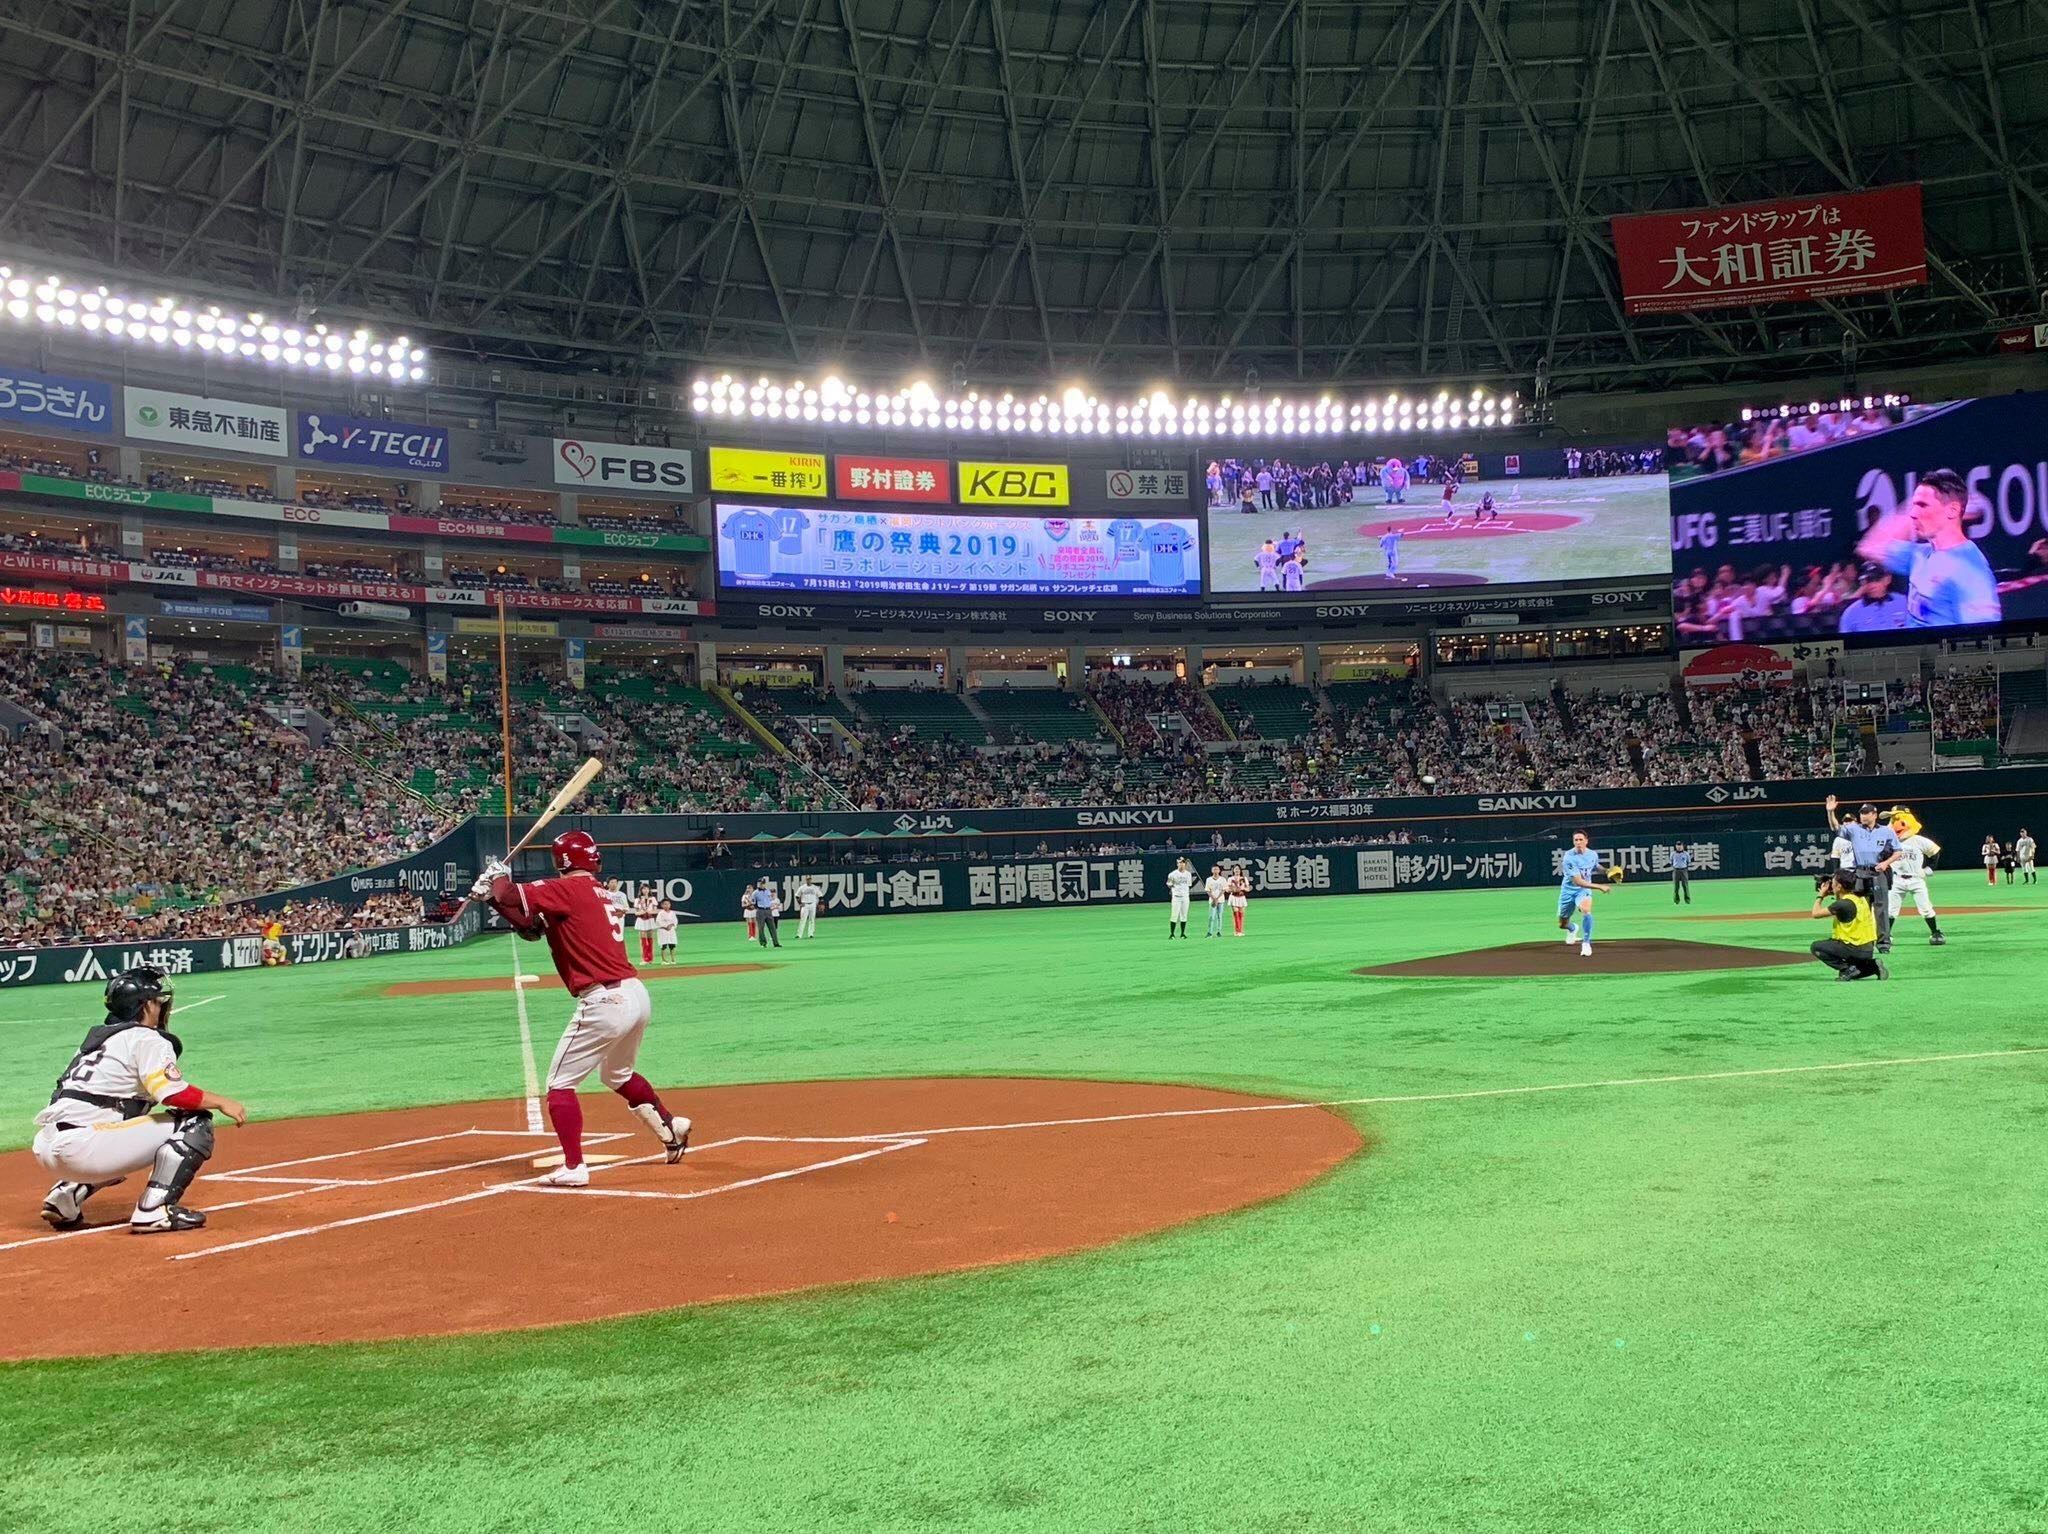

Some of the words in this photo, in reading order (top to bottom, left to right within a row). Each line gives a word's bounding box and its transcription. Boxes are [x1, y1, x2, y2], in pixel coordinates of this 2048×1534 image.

[1681, 203, 1840, 239] ファンドラップは
[1658, 229, 1876, 289] 大和証券
[1840, 399, 1850, 411] H
[1864, 397, 1873, 408] E
[169, 406, 280, 443] 東急不動産
[342, 426, 443, 459] Y-TECH
[789, 456, 821, 468] KIRIN
[601, 457, 687, 486] FBS
[850, 467, 936, 491] 野村證券
[752, 471, 822, 489] 一番搾り
[969, 470, 1056, 498] KBC
[1138, 474, 1185, 495] 禁煙
[85, 484, 151, 503] ECCジュニア
[283, 507, 321, 522] ECC
[603, 533, 659, 547] ECCジュニア
[824, 558, 1030, 576] コラボレーションイベント
[155, 571, 186, 582] JAL
[448, 593, 475, 601] JAL
[1591, 591, 1648, 605] SONY
[663, 603, 689, 611] JAL
[758, 604, 816, 617] SONY
[1316, 606, 1369, 618] SONY
[1405, 598, 1554, 613] ソニービジネスソリューション株式会社
[854, 608, 1008, 621] ソニービジネスソリューション株式会社
[1044, 611, 1097, 621] SONY
[1133, 611, 1154, 622] Sony
[1156, 612, 1193, 621] Business
[1195, 611, 1232, 620] Solutions
[1233, 610, 1281, 621] Corporation
[1733, 786, 1767, 801] 山九
[1478, 796, 1577, 812] SANKYU
[921, 815, 953, 829] 山九
[1077, 810, 1174, 825] SANKYU
[1395, 852, 1522, 884] 博多グリーンホテル
[968, 858, 1145, 904] 西部電気工業
[604, 904, 624, 942] 5
[292, 932, 343, 964] サニクリーン
